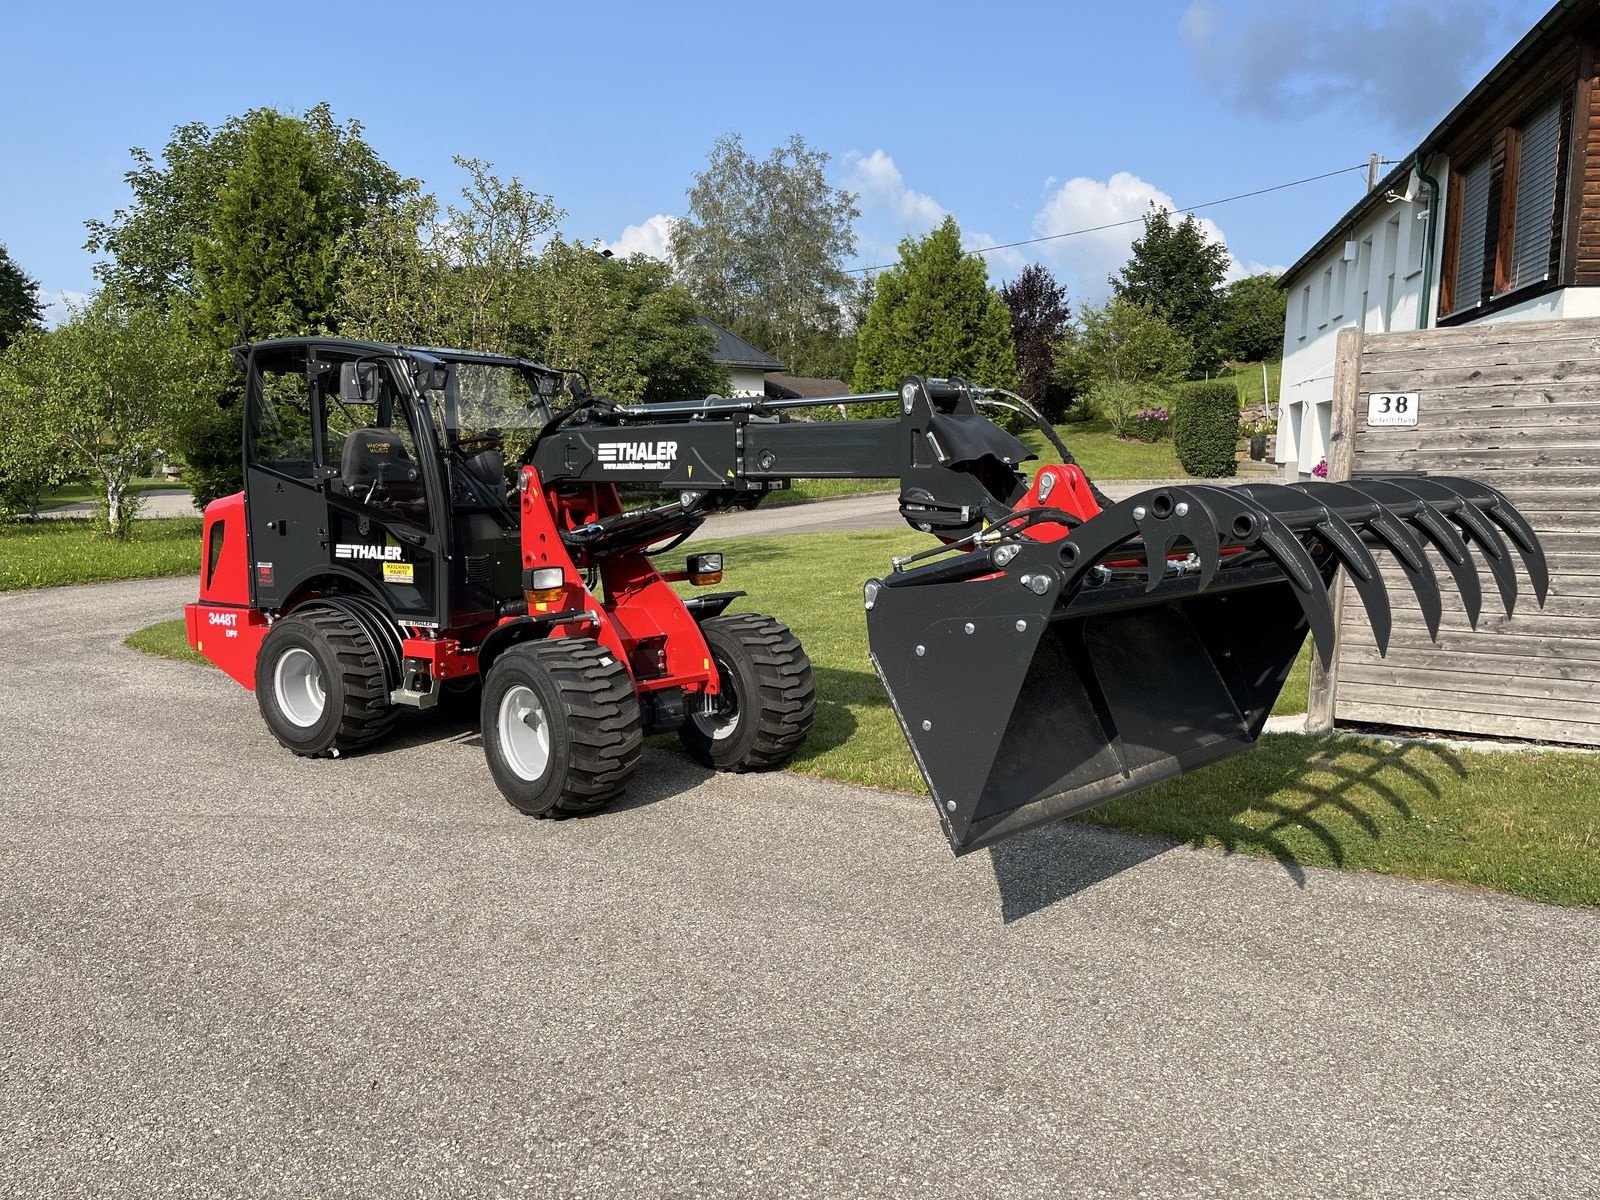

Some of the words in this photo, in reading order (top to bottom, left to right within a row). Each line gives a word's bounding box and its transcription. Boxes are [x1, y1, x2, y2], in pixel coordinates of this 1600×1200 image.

[1378, 396, 1408, 413] 38
[616, 441, 678, 460] THALER
[351, 544, 402, 561] THALER
[208, 611, 238, 627] 3448T
[412, 620, 433, 628] THALER
[225, 629, 239, 639] DPF
